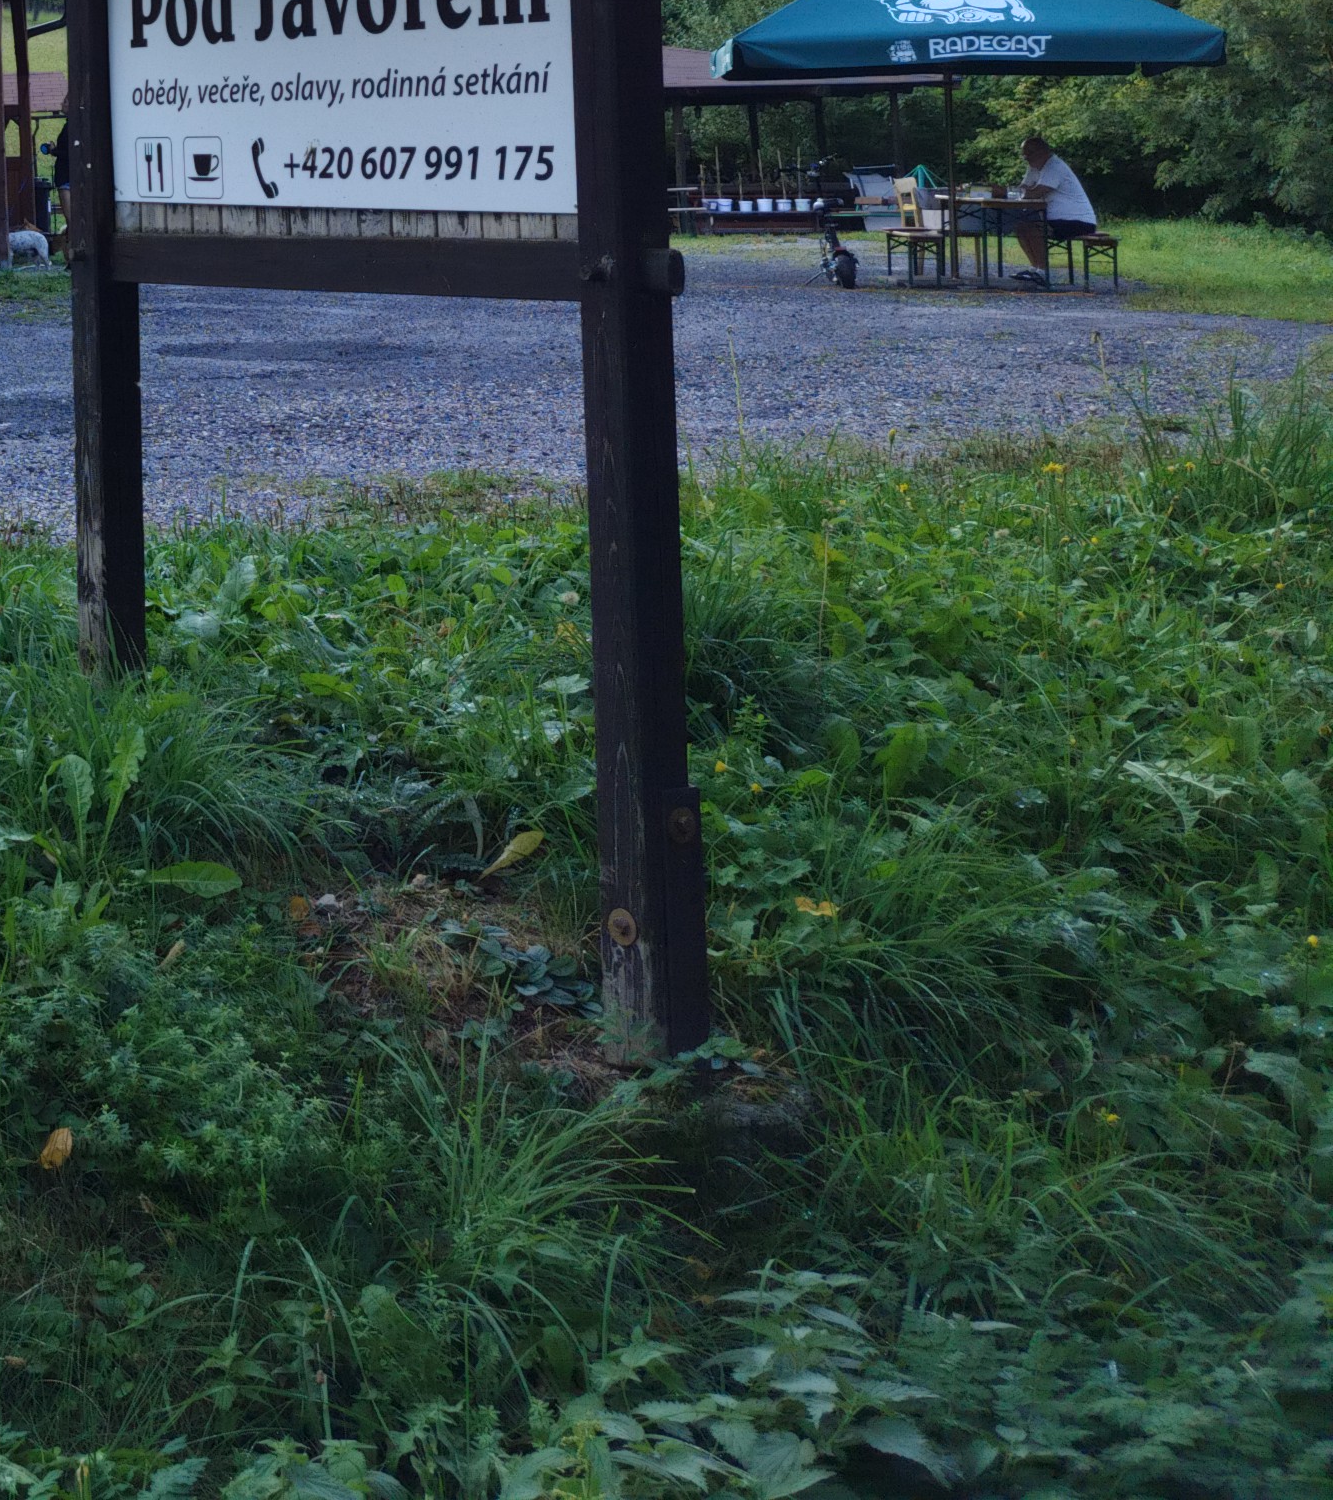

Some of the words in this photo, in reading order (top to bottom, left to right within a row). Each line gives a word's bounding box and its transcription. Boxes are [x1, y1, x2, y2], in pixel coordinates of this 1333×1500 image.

[929, 35, 1052, 59] RADEGAST
[132, 78, 192, 112] obědy,
[197, 75, 265, 106] večeře,
[270, 72, 345, 108] oslavy,
[351, 66, 447, 99] rodinná
[453, 61, 552, 96] setkání
[284, 146, 353, 179] +420
[360, 146, 417, 180] 607
[424, 145, 480, 181] 991
[495, 145, 555, 181] 175
